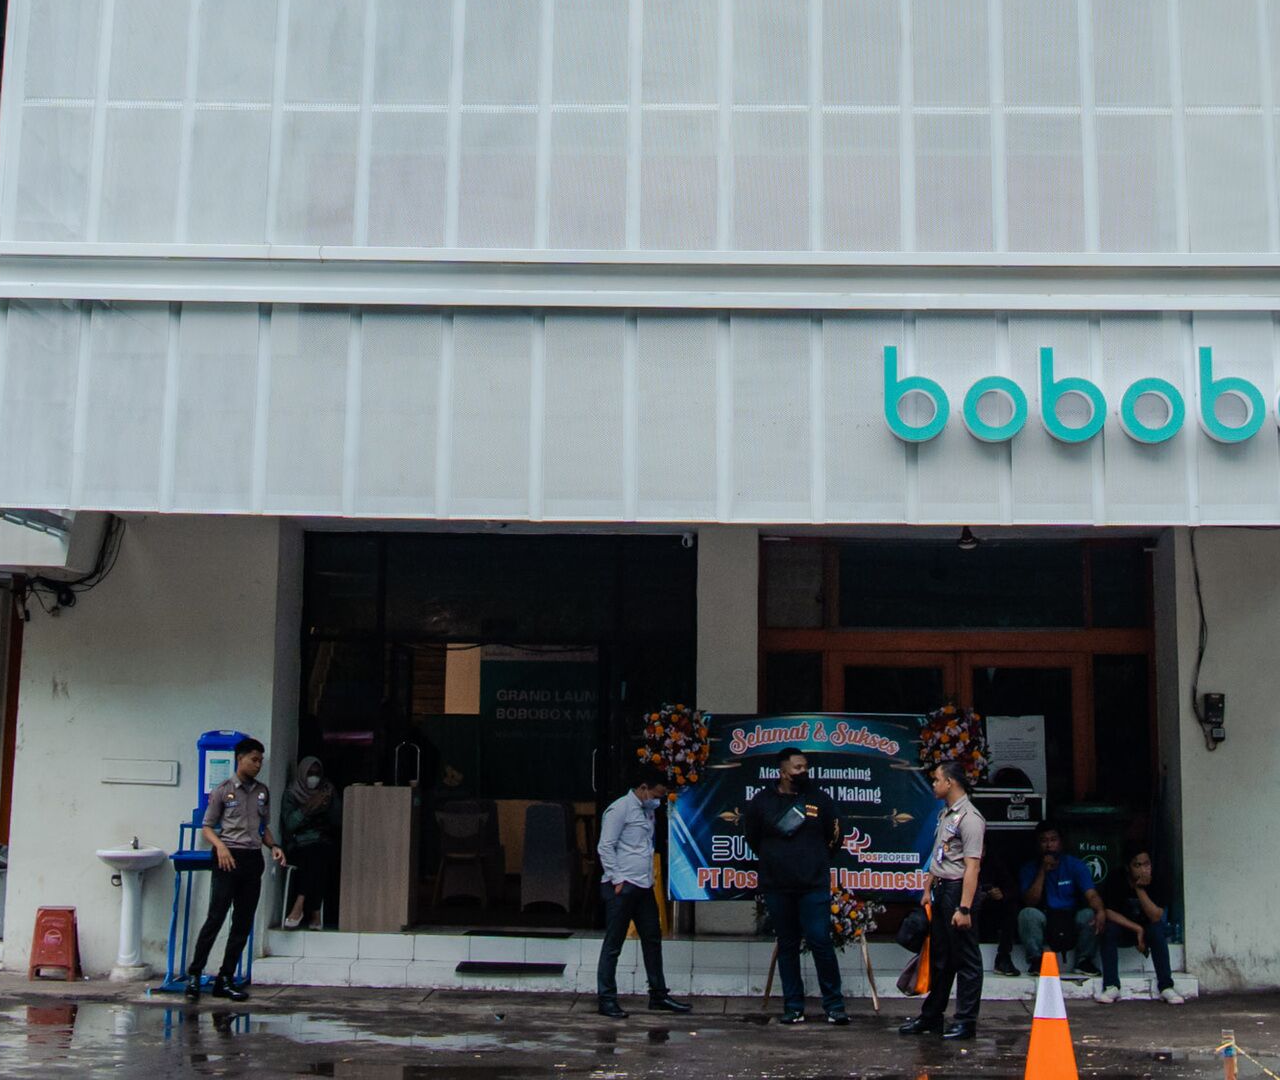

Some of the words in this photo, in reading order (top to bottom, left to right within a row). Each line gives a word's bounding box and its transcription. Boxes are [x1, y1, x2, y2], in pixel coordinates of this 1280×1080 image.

[729, 722, 809, 755] Selamat
[830, 721, 900, 756] Sukses
[818, 766, 872, 782] Launching
[837, 785, 882, 803] Malang
[697, 868, 721, 889] PT
[722, 867, 759, 889] Pos
